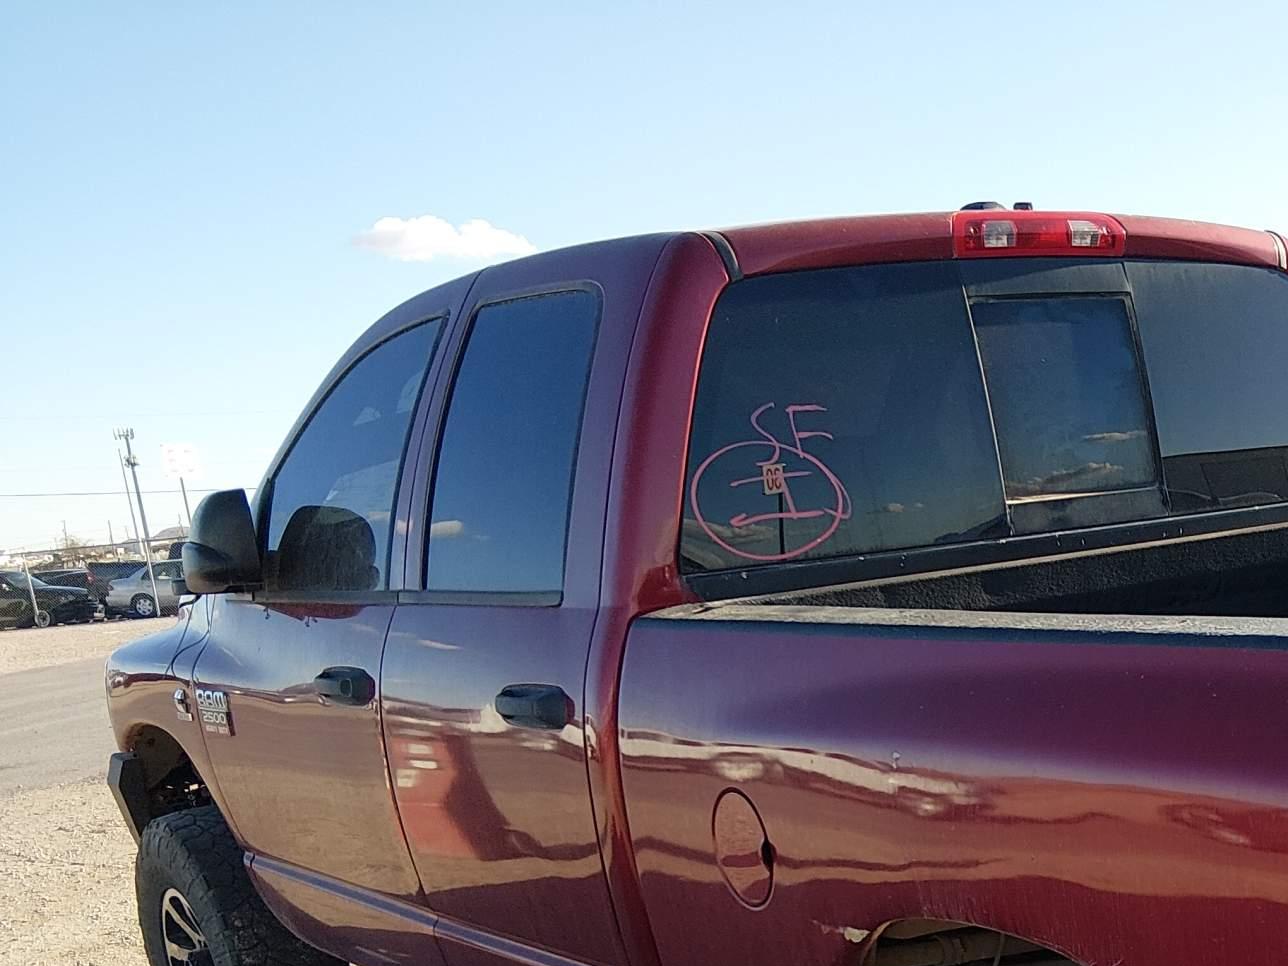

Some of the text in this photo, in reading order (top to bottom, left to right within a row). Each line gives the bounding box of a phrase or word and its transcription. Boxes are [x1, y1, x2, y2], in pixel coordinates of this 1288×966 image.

[751, 402, 834, 467] SF
[195, 689, 227, 709] RAM
[202, 710, 227, 724] 2500
